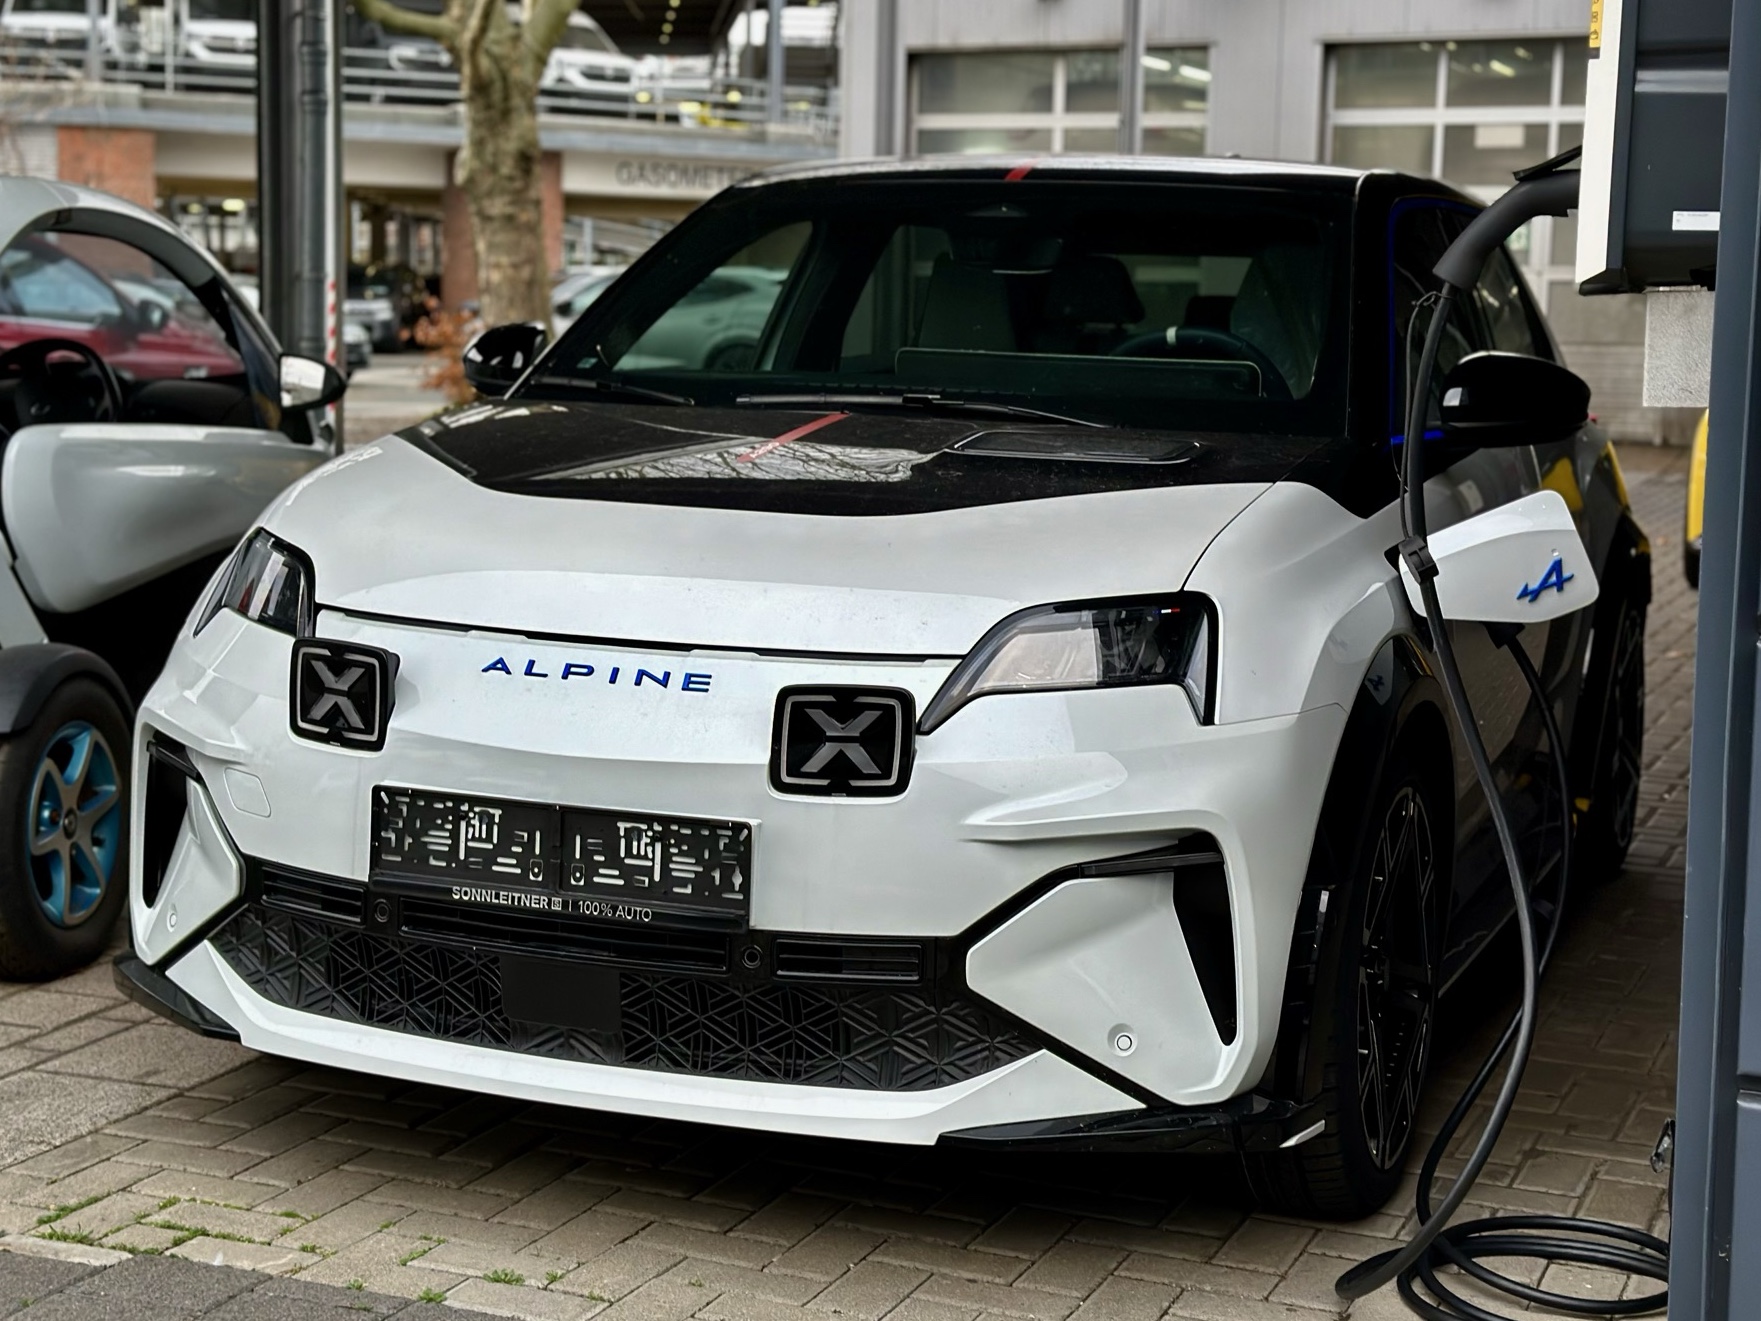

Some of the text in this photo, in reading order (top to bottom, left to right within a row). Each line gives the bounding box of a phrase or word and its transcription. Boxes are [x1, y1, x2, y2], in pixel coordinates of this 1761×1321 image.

[481, 656, 713, 693] ALPINE
[451, 885, 549, 910] SONNLEITNER
[577, 900, 613, 917] 100%
[615, 904, 652, 922] AUTO
